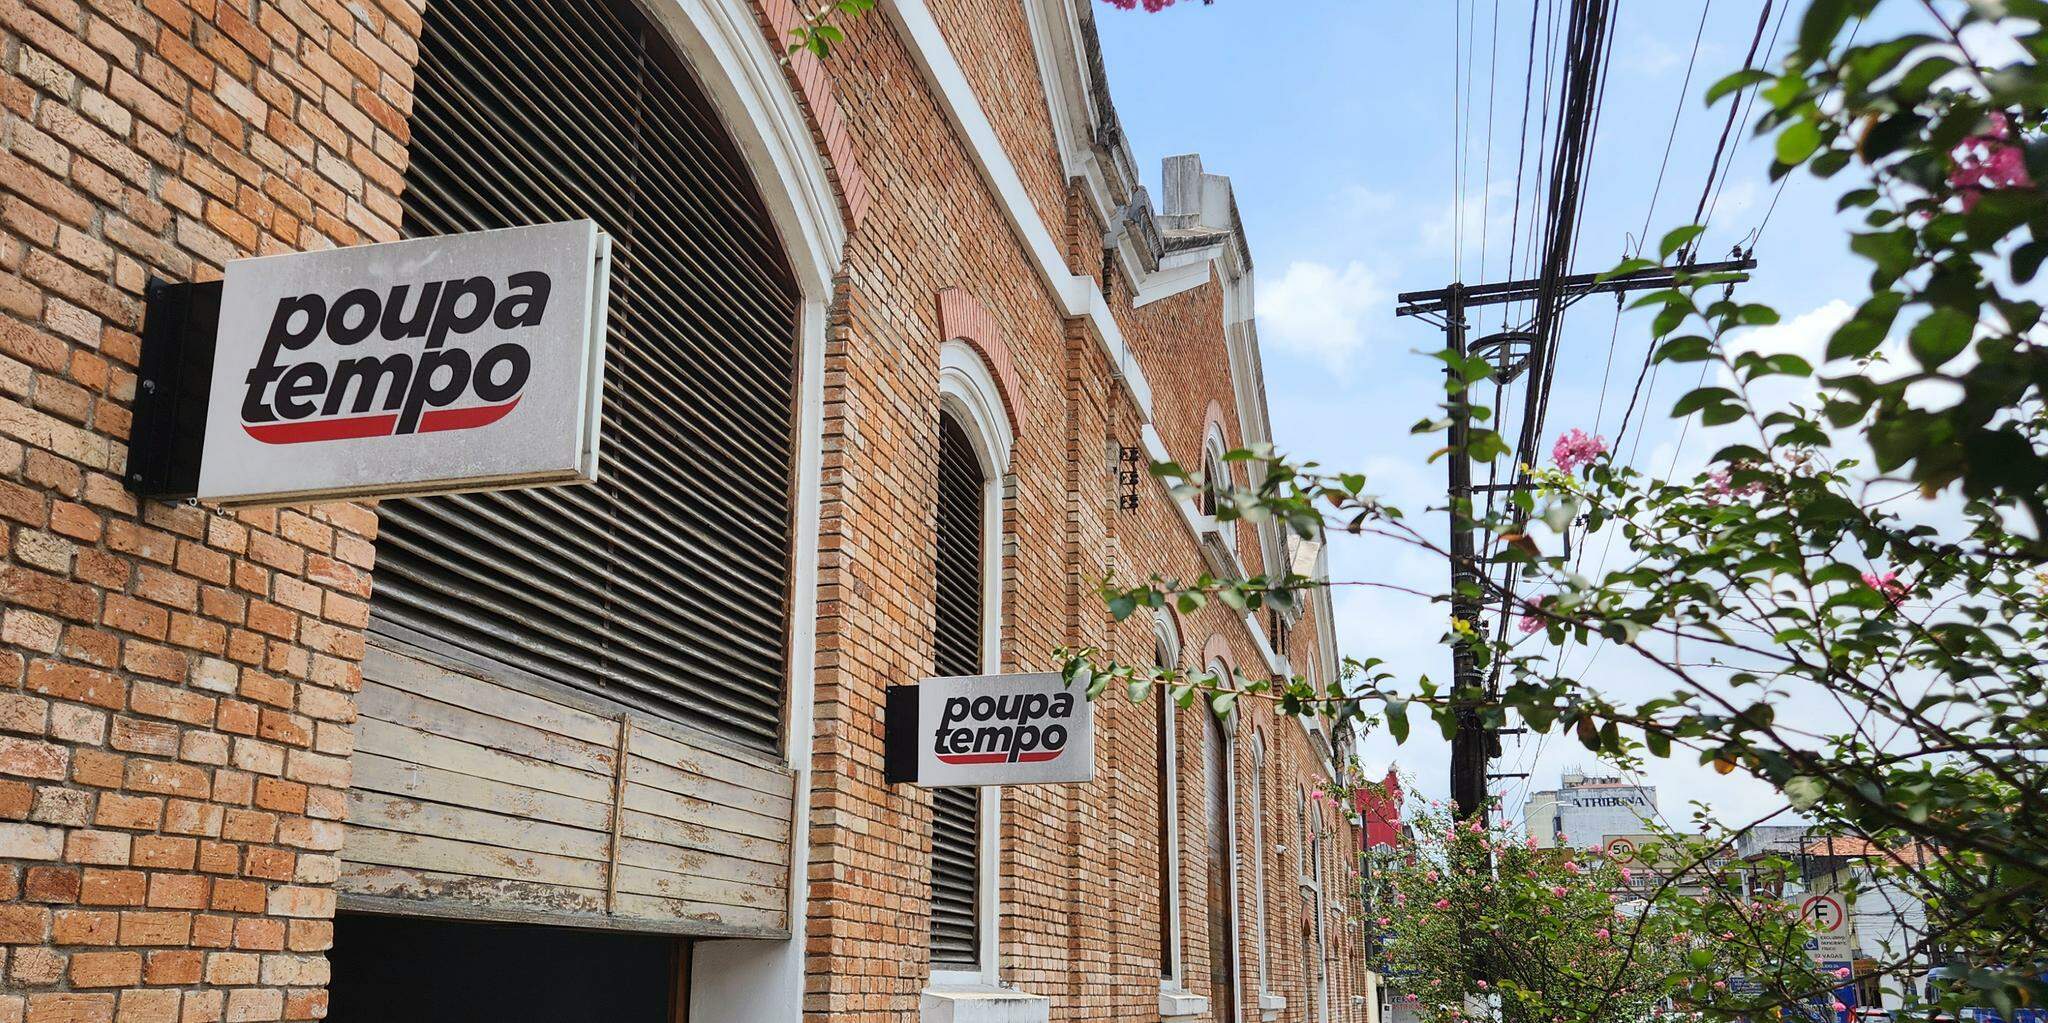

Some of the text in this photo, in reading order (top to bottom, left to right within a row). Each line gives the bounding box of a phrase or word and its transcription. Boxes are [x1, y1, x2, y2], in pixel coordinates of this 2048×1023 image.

[256, 270, 551, 367] poupa
[240, 342, 531, 435] tempo
[939, 692, 1074, 730] poupa
[934, 724, 1068, 763] tempo
[1572, 796, 1646, 808] A TRIBUNA
[1613, 844, 1630, 854] 50
